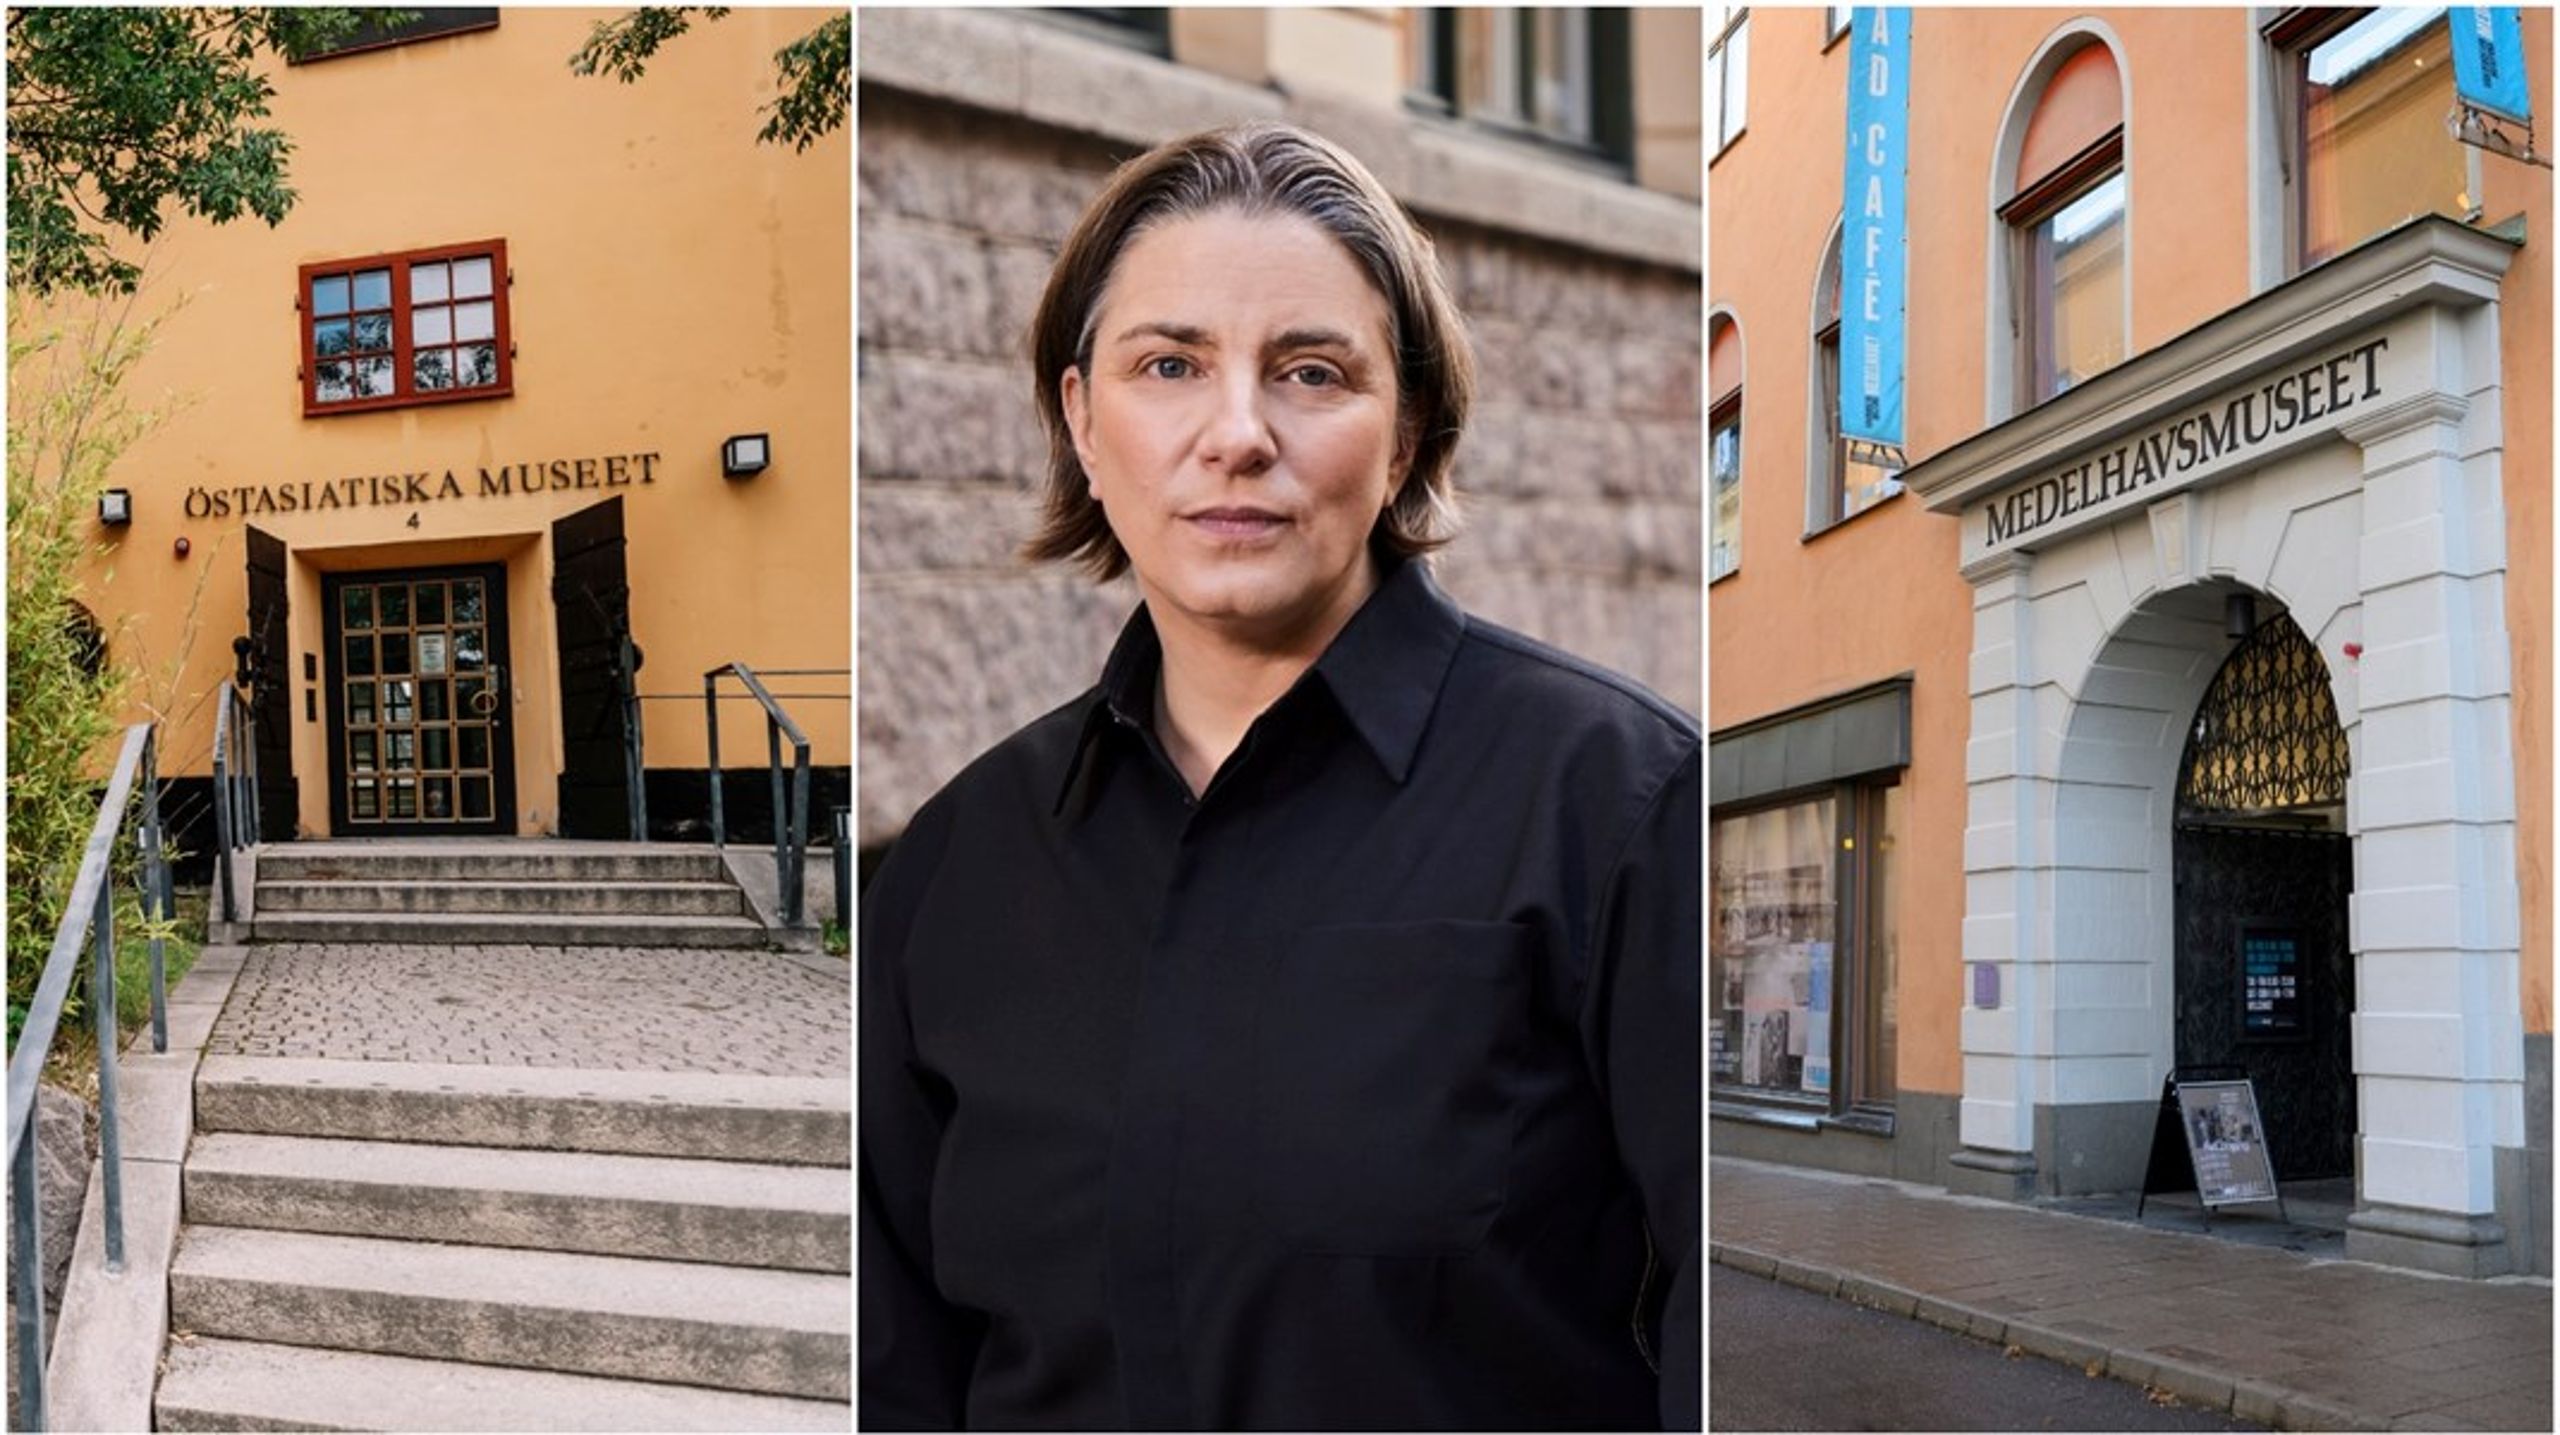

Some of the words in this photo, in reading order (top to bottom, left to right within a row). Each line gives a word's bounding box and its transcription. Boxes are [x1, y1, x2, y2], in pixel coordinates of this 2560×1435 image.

[1864, 123, 1887, 322] CAFÉ
[185, 470, 464, 520] ÖSTASIATISKA
[478, 451, 661, 498] MUSEET
[1985, 337, 2388, 547] MEDELHAVSMUSEET
[406, 512, 420, 530] 4
